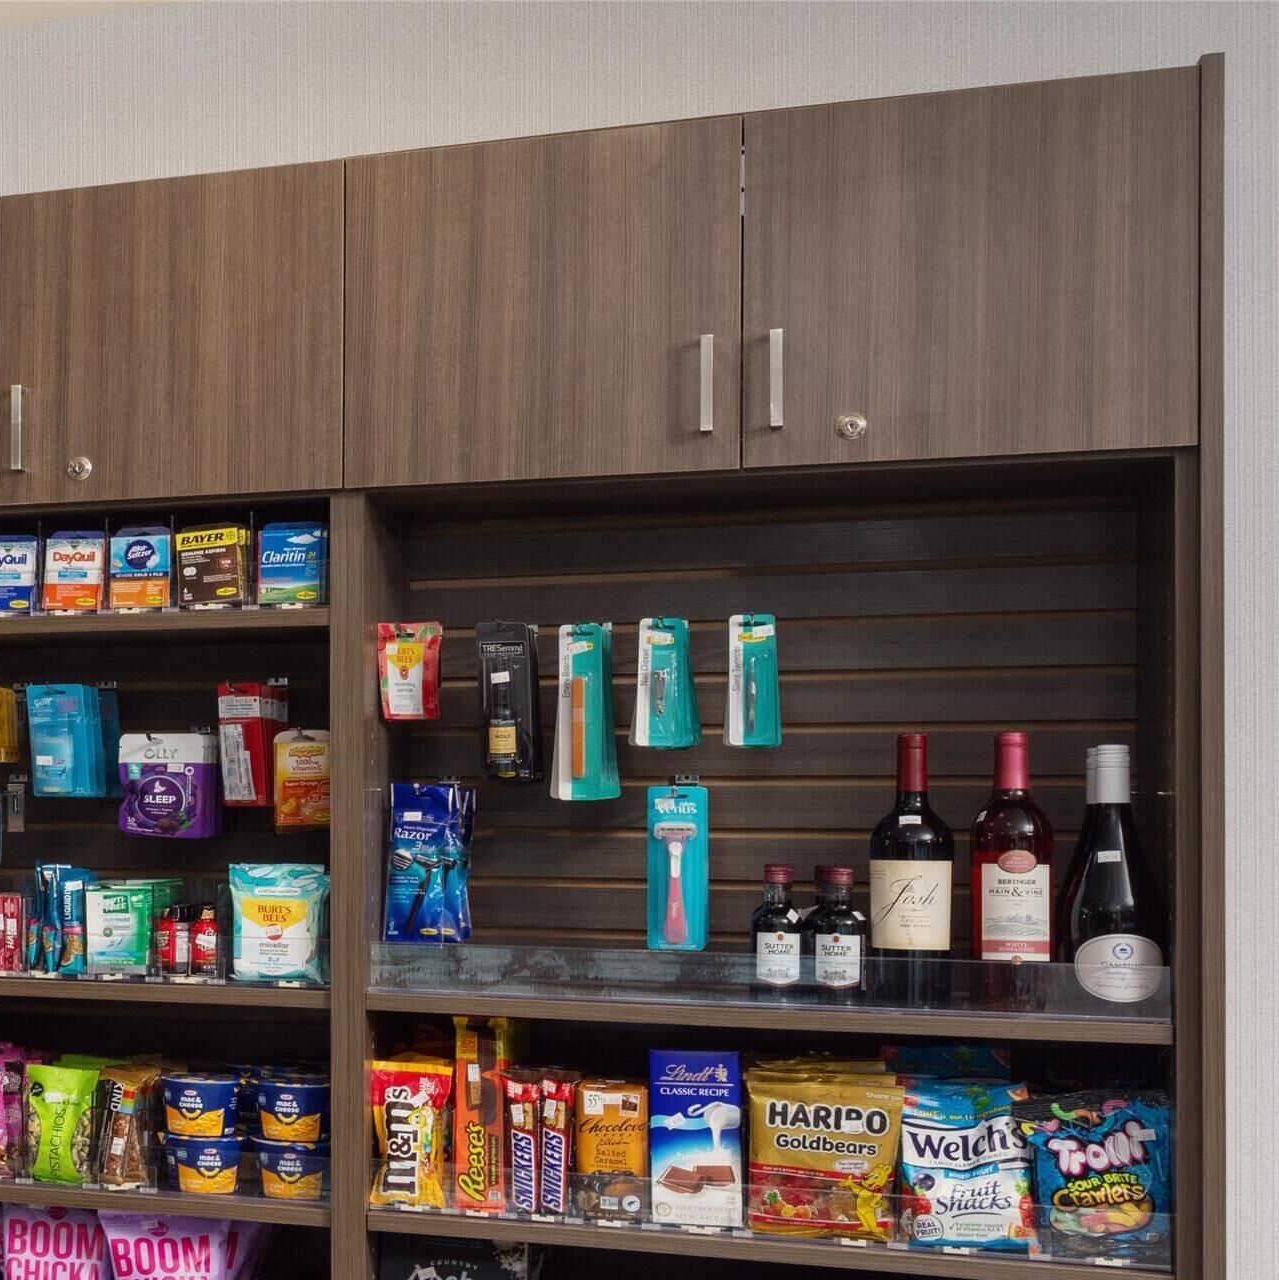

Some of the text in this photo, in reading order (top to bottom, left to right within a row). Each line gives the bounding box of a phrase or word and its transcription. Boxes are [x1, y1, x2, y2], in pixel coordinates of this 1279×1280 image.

[180, 532, 225, 546] BAYER
[53, 551, 95, 564] DayQuil
[262, 550, 306, 564] Claritin
[144, 749, 178, 760] OLLY
[143, 795, 176, 804] SLEEP
[394, 828, 433, 842] Razor
[258, 904, 292, 914] BURT'S
[873, 875, 939, 928] Josh
[262, 914, 287, 922] BEES
[660, 1064, 714, 1082] Lindt
[110, 1083, 125, 1113] KIND
[660, 1087, 730, 1097] CLASSIC RECIPE
[579, 1116, 646, 1134] Chocolove
[50, 1107, 66, 1178] PISTACHIOS
[775, 1133, 877, 1157] Goldbears
[906, 1121, 1028, 1161] Welch's
[456, 1121, 487, 1203] Reese's
[594, 1156, 628, 1166] Caramel
[596, 1149, 627, 1159] Salted
[513, 1131, 534, 1211] SNICKERS
[541, 1130, 564, 1211] SNICKERS
[951, 1180, 1002, 1198] Fruit
[1067, 1172, 1139, 1194] SOUR BRITE
[934, 1194, 1012, 1215] Snacks
[1052, 1181, 1146, 1212] Crawlers
[916, 1221, 936, 1229] REAL
[7, 1218, 105, 1262] BOOM
[111, 1235, 211, 1277] BOOM
[430, 1260, 478, 1271] COUNTRY
